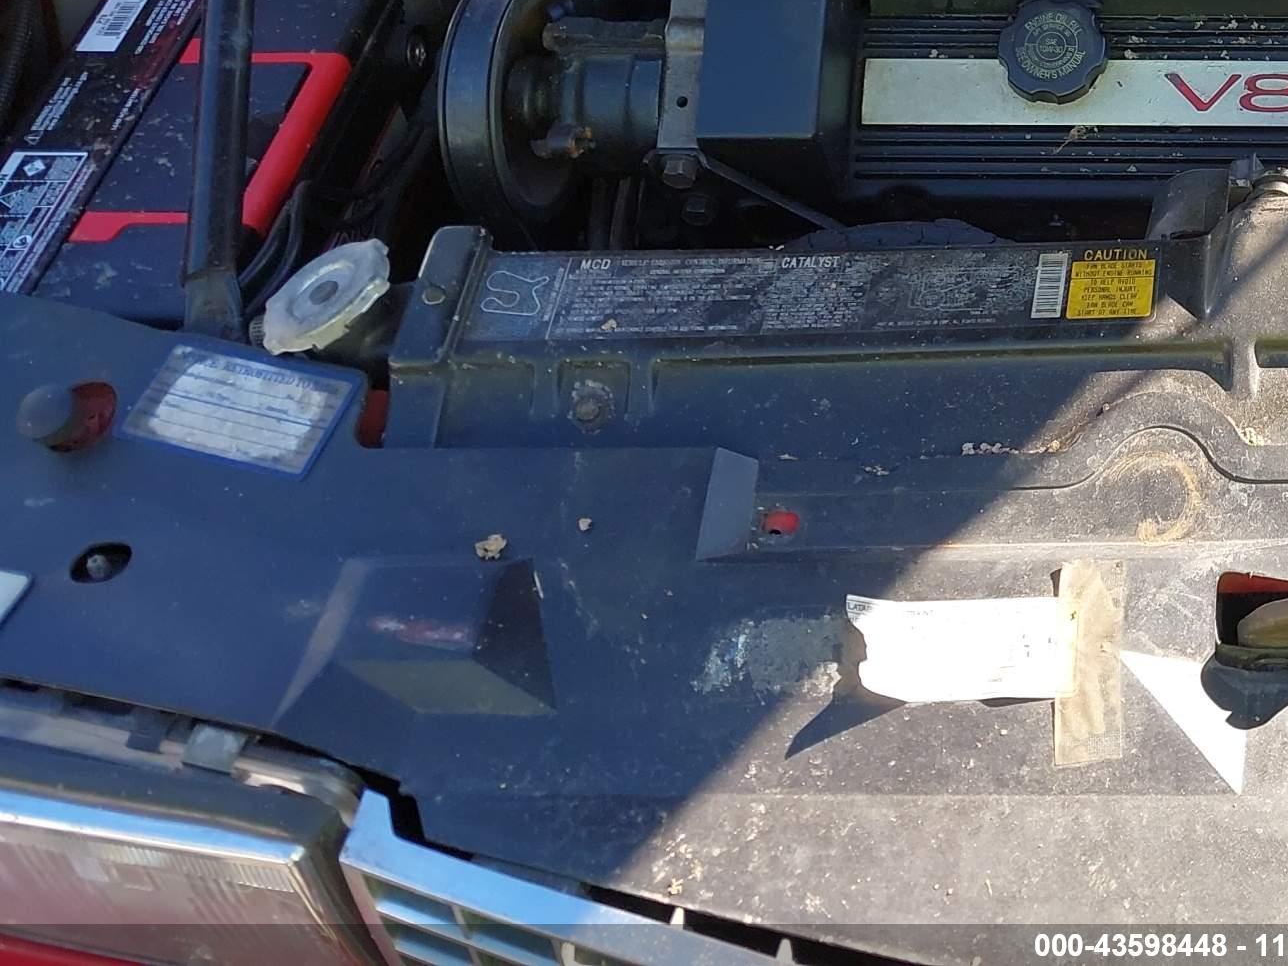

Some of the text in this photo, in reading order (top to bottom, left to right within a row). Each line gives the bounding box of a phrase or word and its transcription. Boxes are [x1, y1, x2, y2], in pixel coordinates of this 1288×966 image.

[1025, 12, 1083, 35] ENGINE OIL FILL
[1058, 51, 1086, 77] MANUAL
[1084, 249, 1148, 261] CAUTION
[580, 258, 611, 270] MCD
[781, 256, 841, 268] CATALYST
